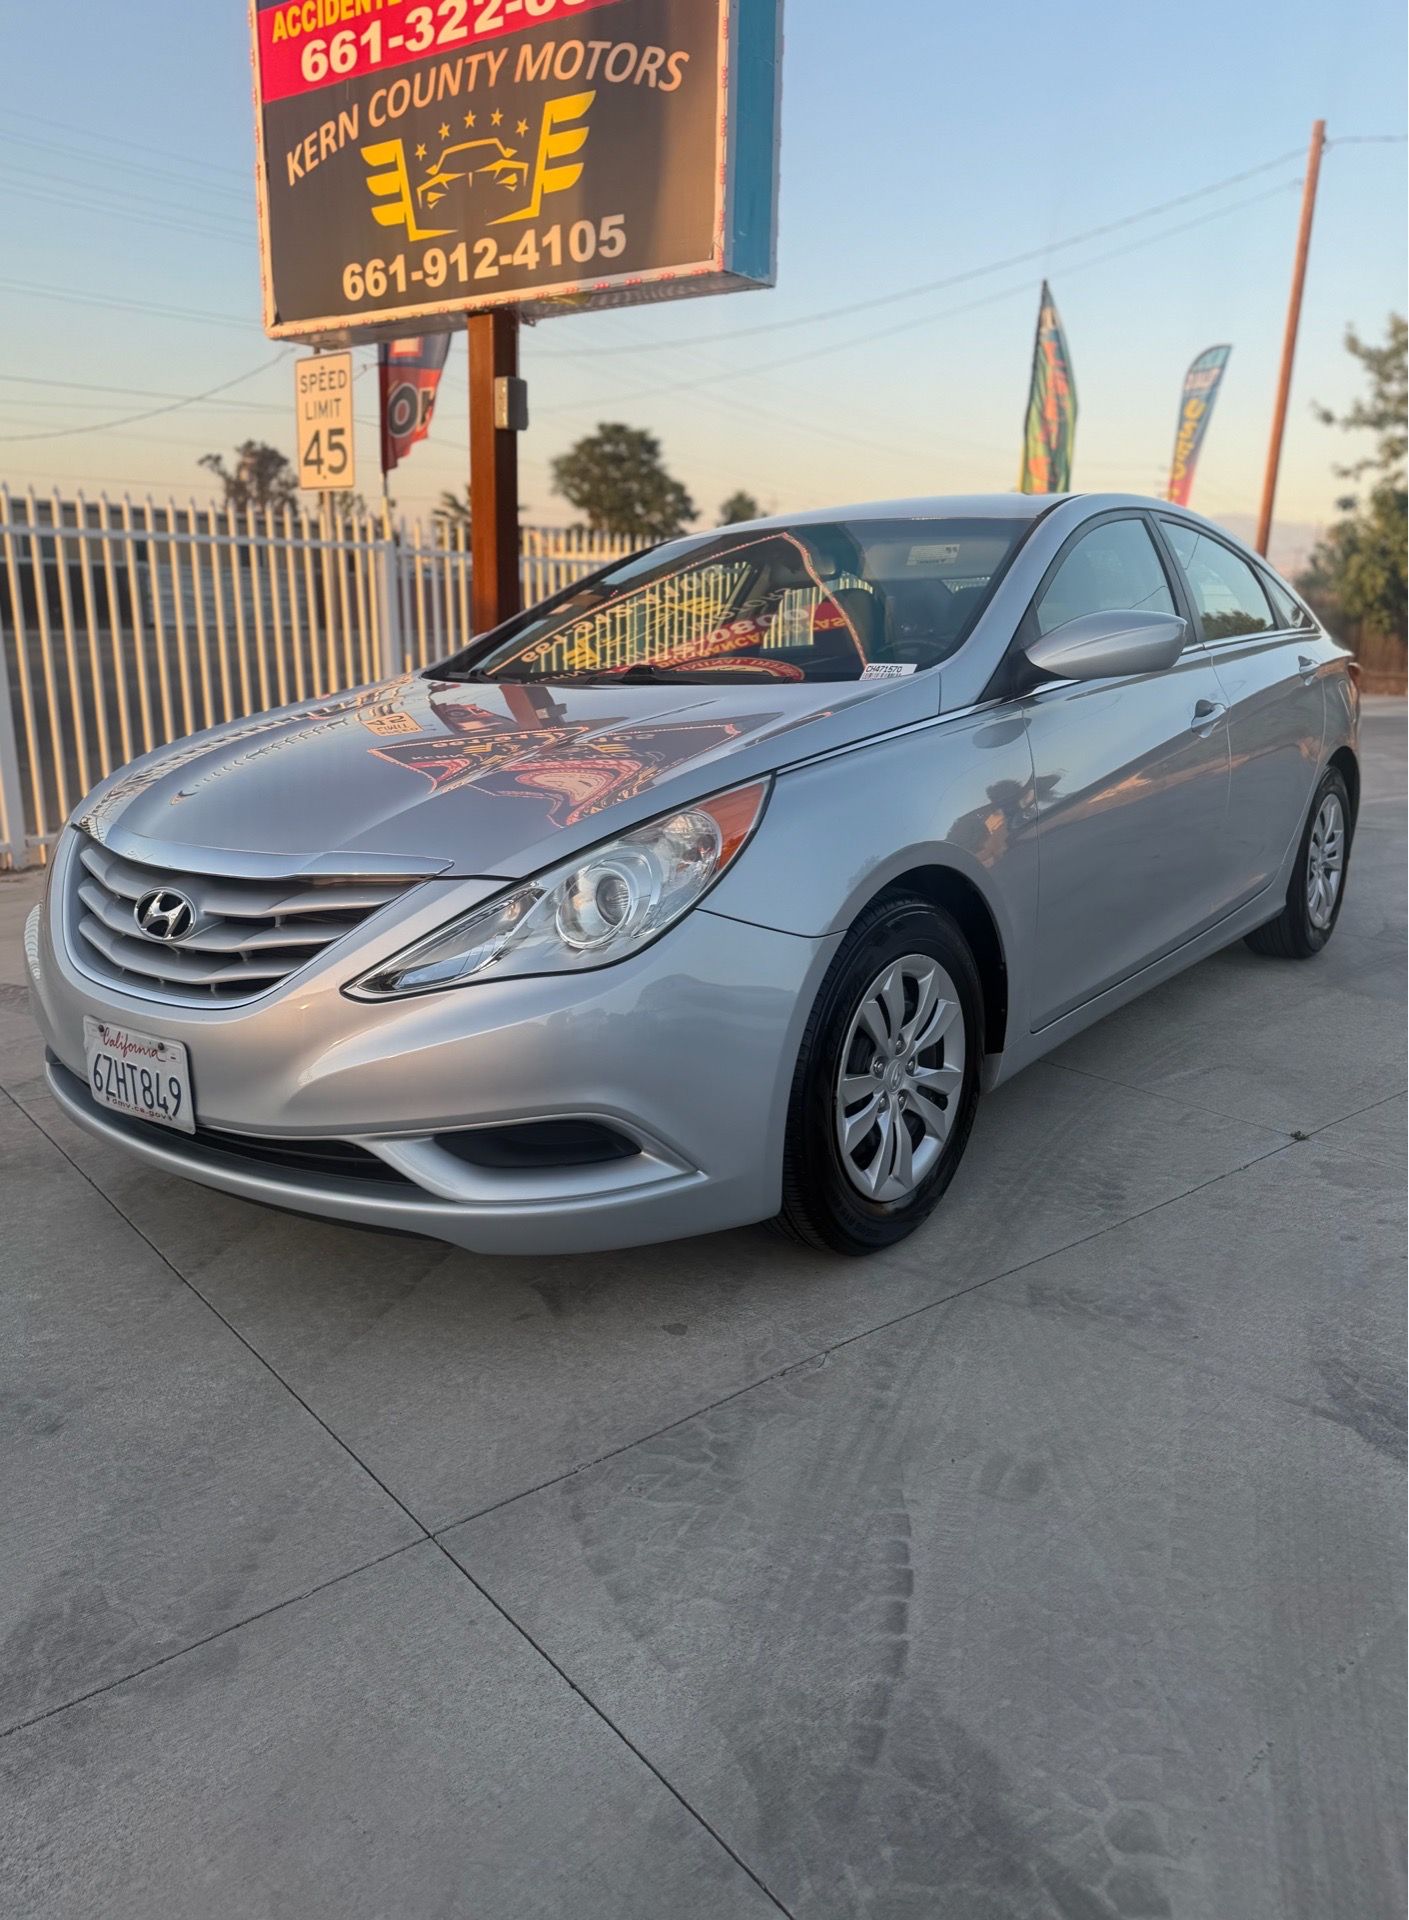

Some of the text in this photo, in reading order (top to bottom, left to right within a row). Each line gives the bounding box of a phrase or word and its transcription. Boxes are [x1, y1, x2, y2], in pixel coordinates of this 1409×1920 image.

[272, 0, 404, 43] ACCIDEN
[300, 0, 587, 82] 661-322-
[286, 39, 690, 187] KERN COUNTY MOTORS
[342, 214, 627, 301] 661-912-4105
[300, 369, 348, 394] SPEED
[304, 397, 342, 421] LIMIT
[302, 427, 348, 476] 45
[102, 1026, 166, 1063] California
[93, 1052, 182, 1117] 6ZHT849
